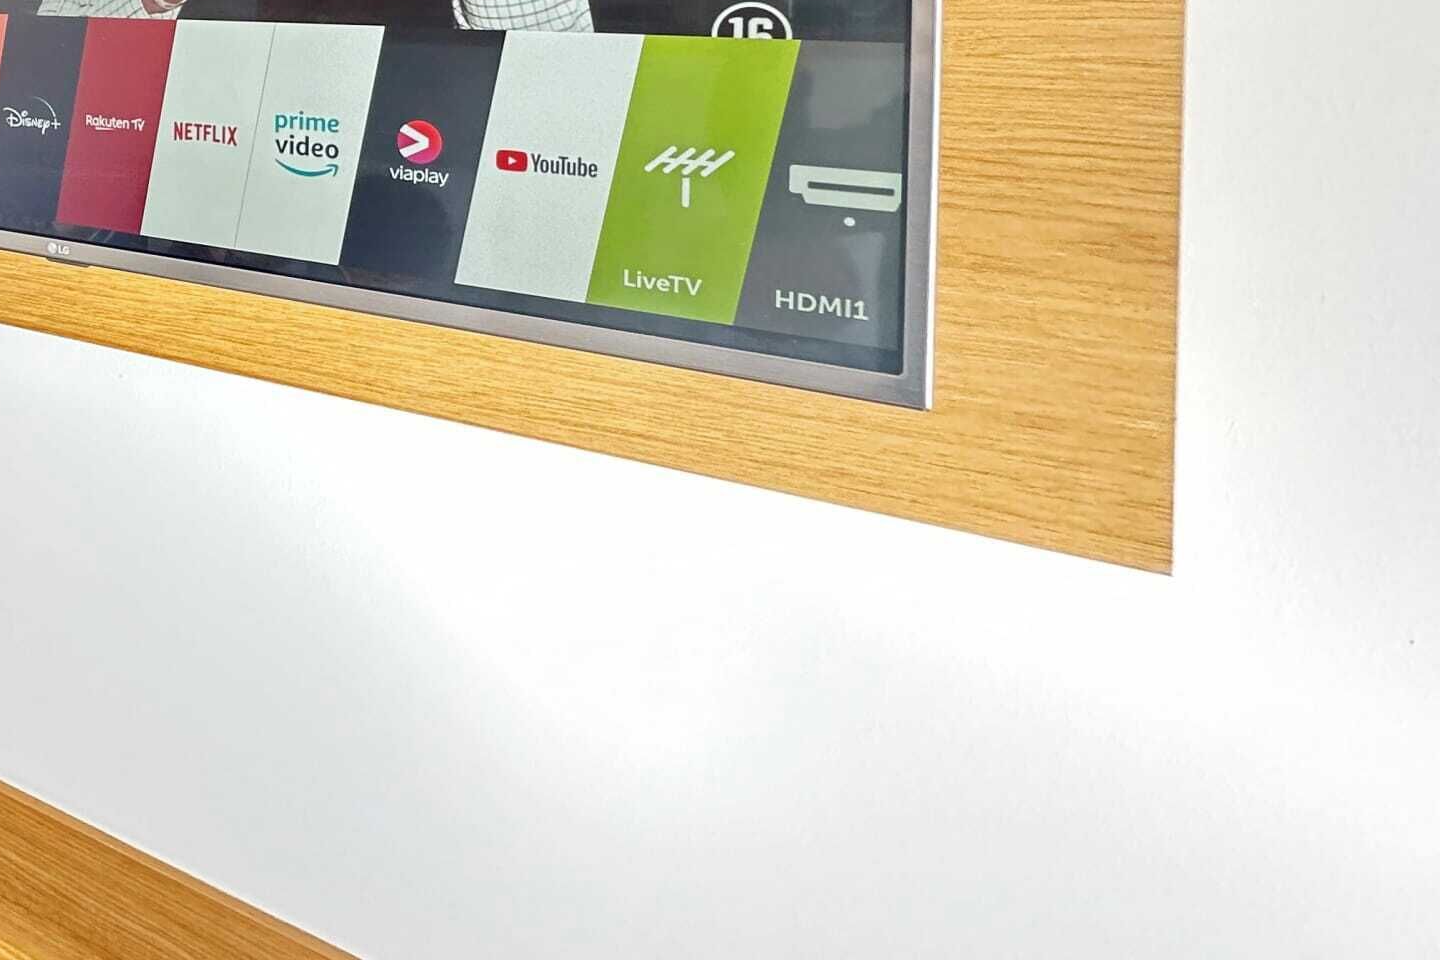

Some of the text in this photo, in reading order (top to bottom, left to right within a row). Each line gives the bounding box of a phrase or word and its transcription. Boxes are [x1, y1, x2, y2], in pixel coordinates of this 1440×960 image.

[728, 16, 774, 39] 16
[85, 114, 130, 130] Rakuten
[275, 110, 340, 133] prime
[173, 121, 238, 146] NETFLIX
[275, 135, 340, 159] video
[389, 165, 449, 187] viaplay
[530, 153, 598, 178] YouTube
[58, 244, 70, 255] LG
[623, 269, 702, 297] LiveTV
[775, 289, 869, 321] HDMI1
